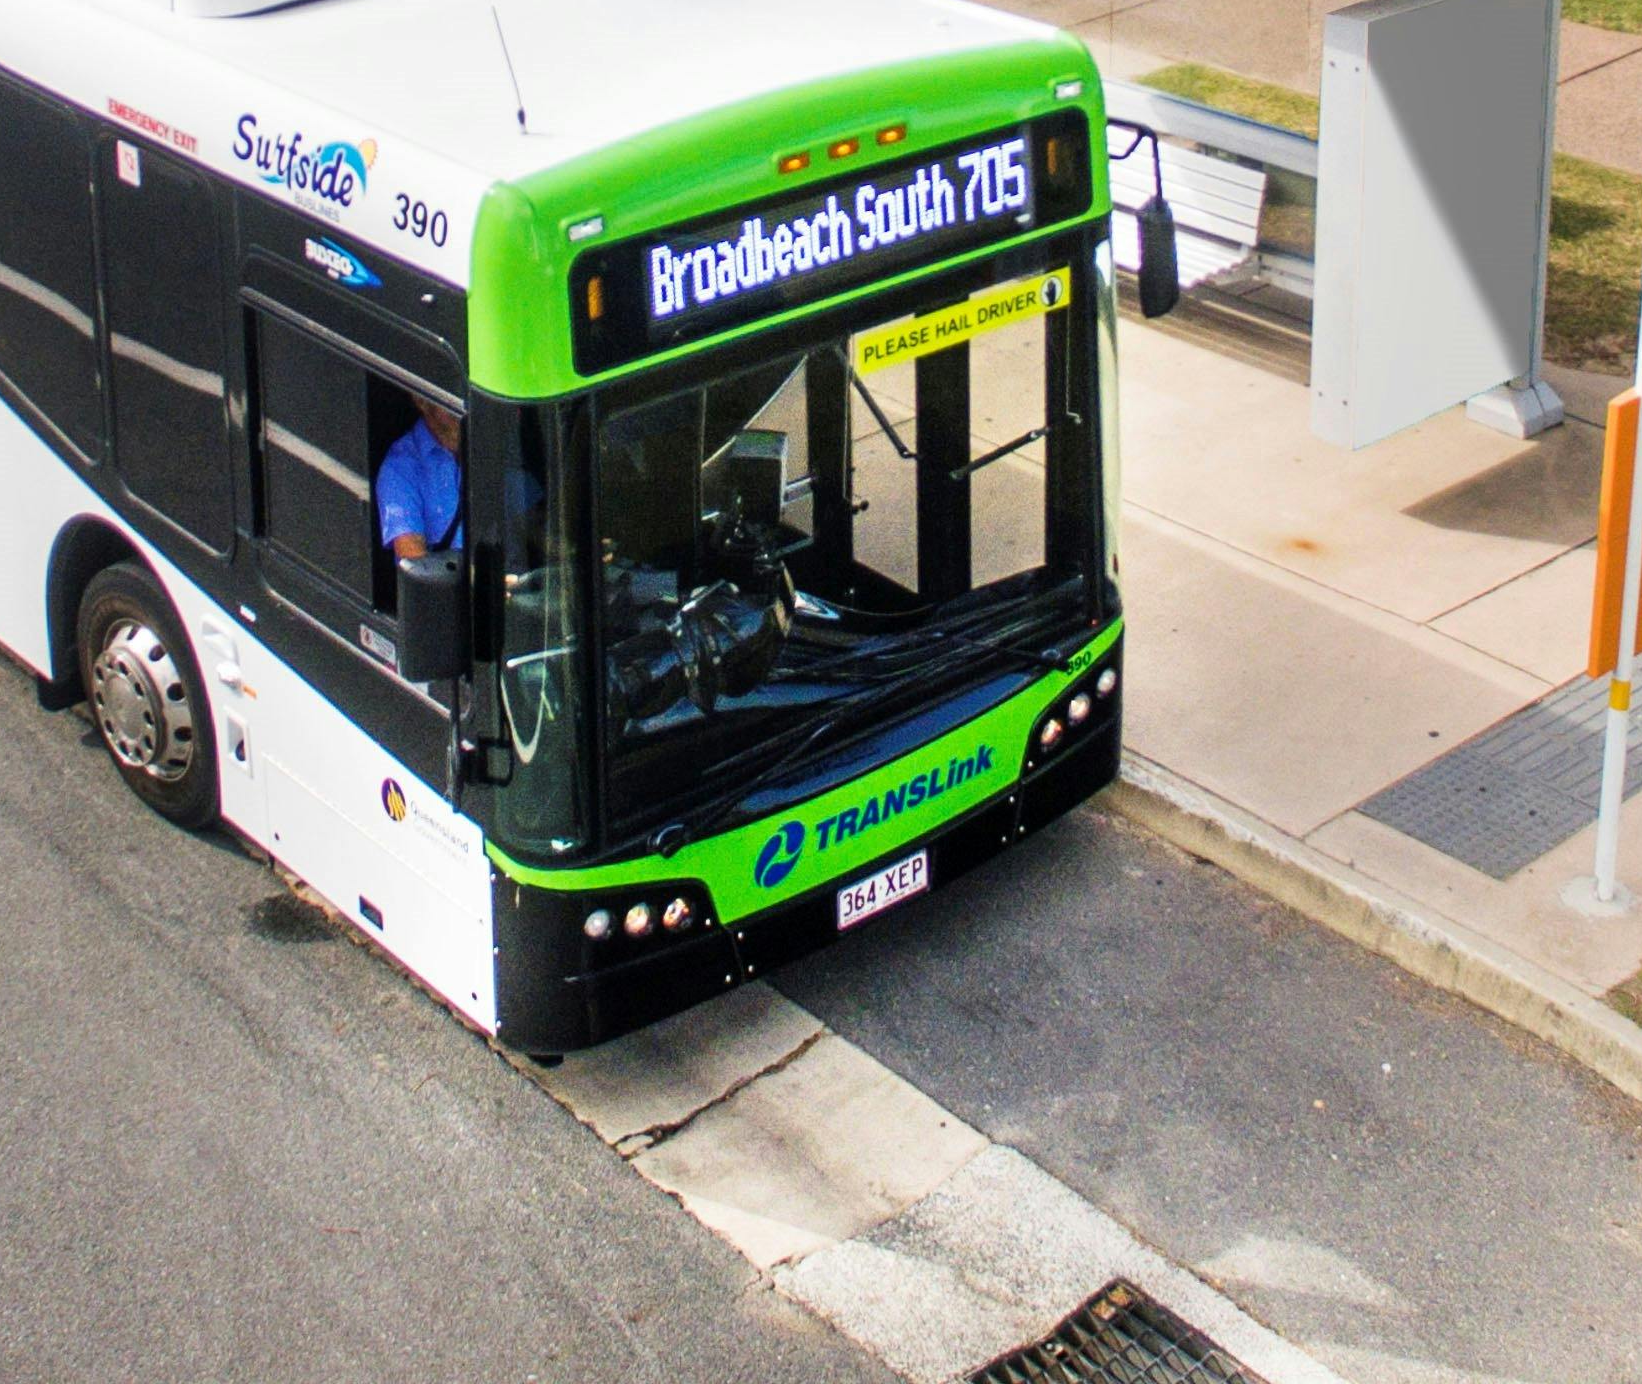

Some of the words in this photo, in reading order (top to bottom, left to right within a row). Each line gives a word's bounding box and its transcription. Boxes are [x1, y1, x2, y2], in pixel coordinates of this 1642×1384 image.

[108, 97, 169, 139] EMERGENCY
[173, 128, 198, 154] EXIT
[233, 113, 355, 207] Surfside
[393, 172, 448, 248] 390
[651, 195, 854, 317] Broadbeach
[856, 163, 957, 252] South
[958, 137, 1026, 222] 705
[863, 327, 930, 363] PLEASE
[935, 315, 972, 339] HAIL
[977, 290, 1037, 324] DRIVER
[816, 743, 995, 852] TRANSLink
[885, 857, 924, 898] XEP
